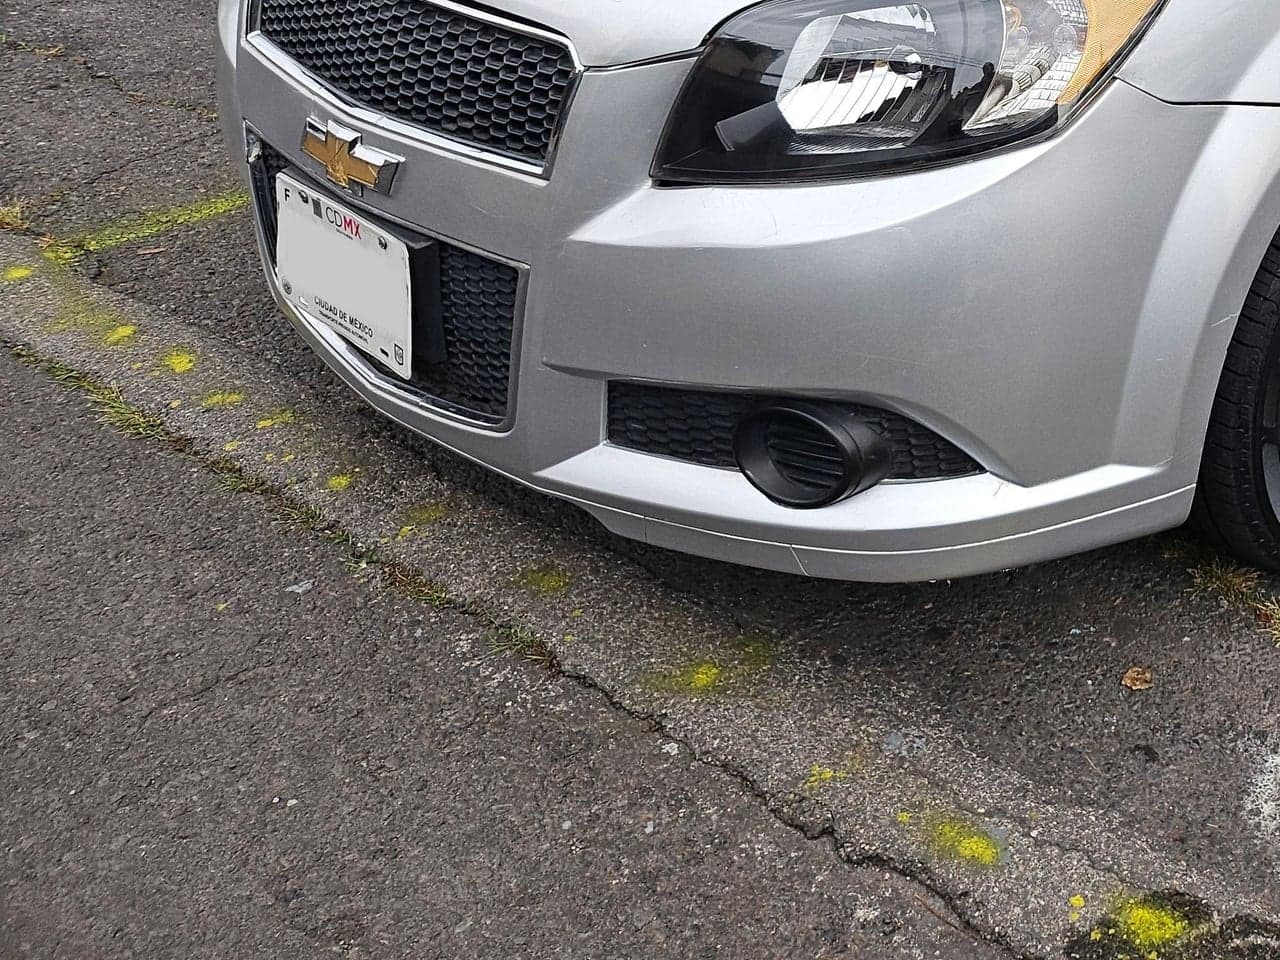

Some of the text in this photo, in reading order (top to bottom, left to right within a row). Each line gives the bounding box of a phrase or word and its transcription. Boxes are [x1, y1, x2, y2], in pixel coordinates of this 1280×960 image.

[284, 188, 290, 202] F
[326, 206, 361, 240] CDMX
[314, 296, 338, 316] CIUDAD
[339, 310, 348, 323] DE
